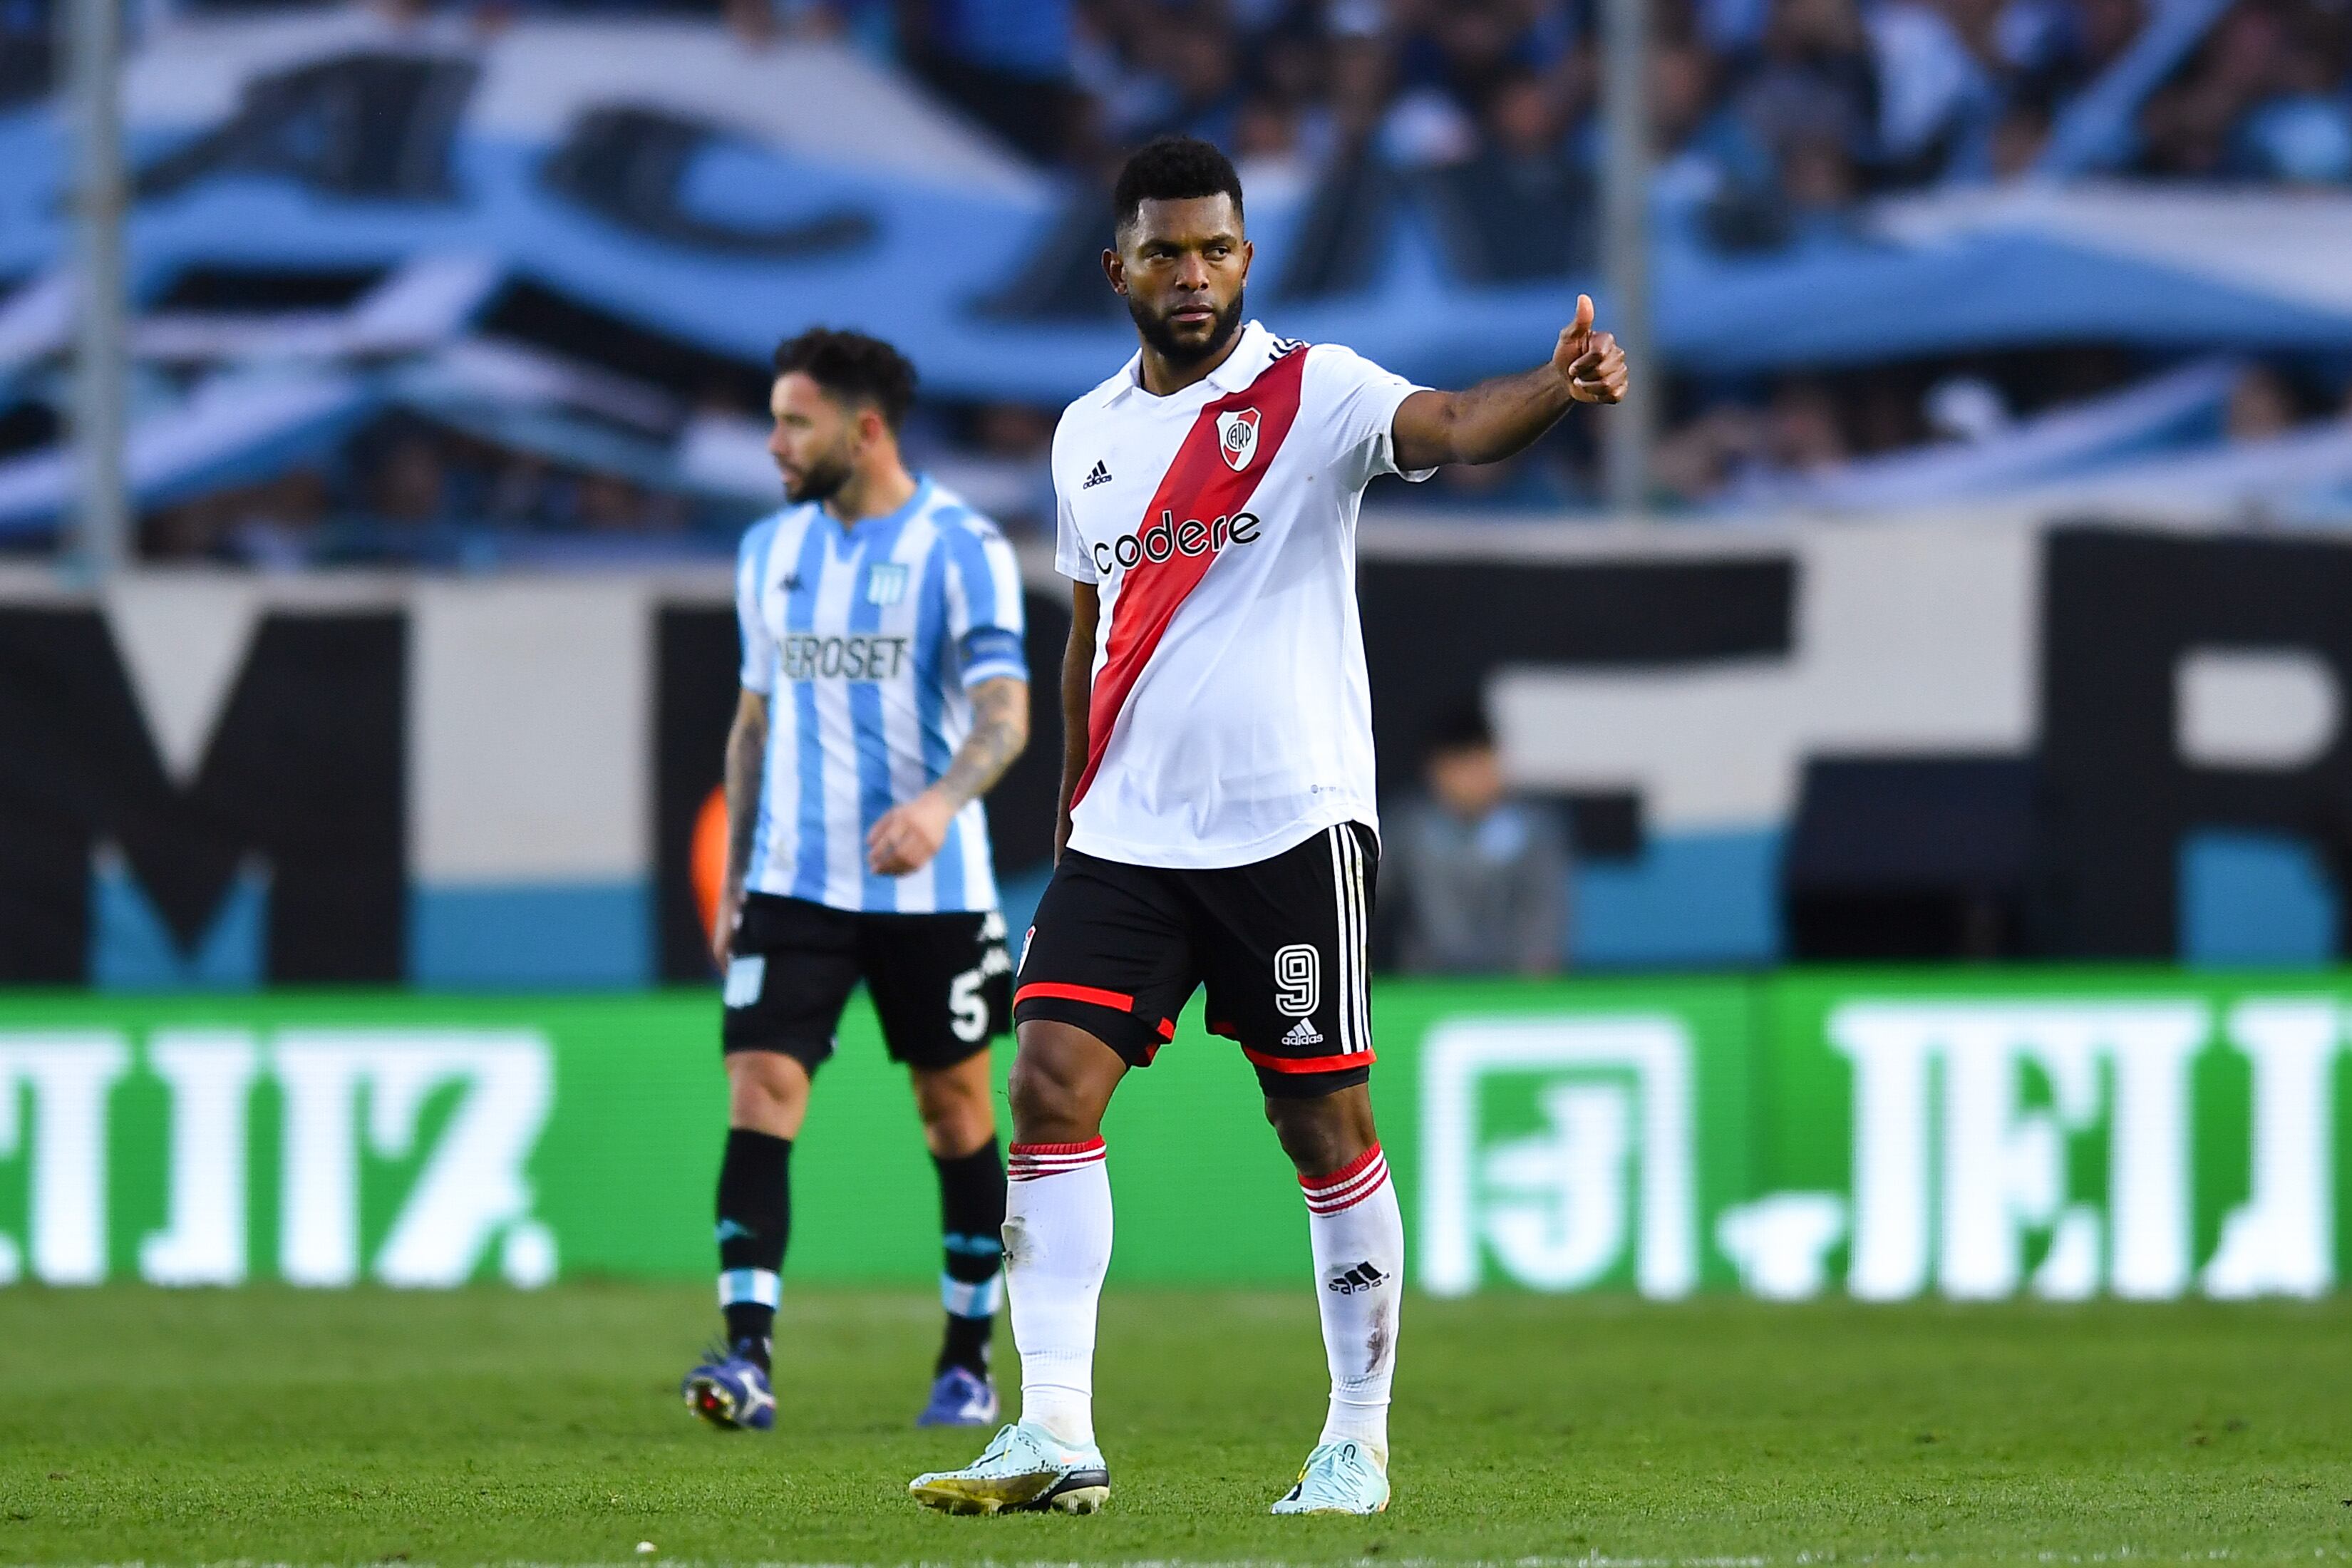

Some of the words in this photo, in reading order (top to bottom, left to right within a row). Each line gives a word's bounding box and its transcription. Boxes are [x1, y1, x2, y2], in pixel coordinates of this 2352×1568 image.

[1083, 474, 1113, 490] adidas
[1093, 510, 1262, 576] codere
[775, 632, 908, 681] EROSET
[949, 967, 991, 1043] 5
[1274, 943, 1321, 1018] 9
[1281, 1033, 1324, 1046] adidas
